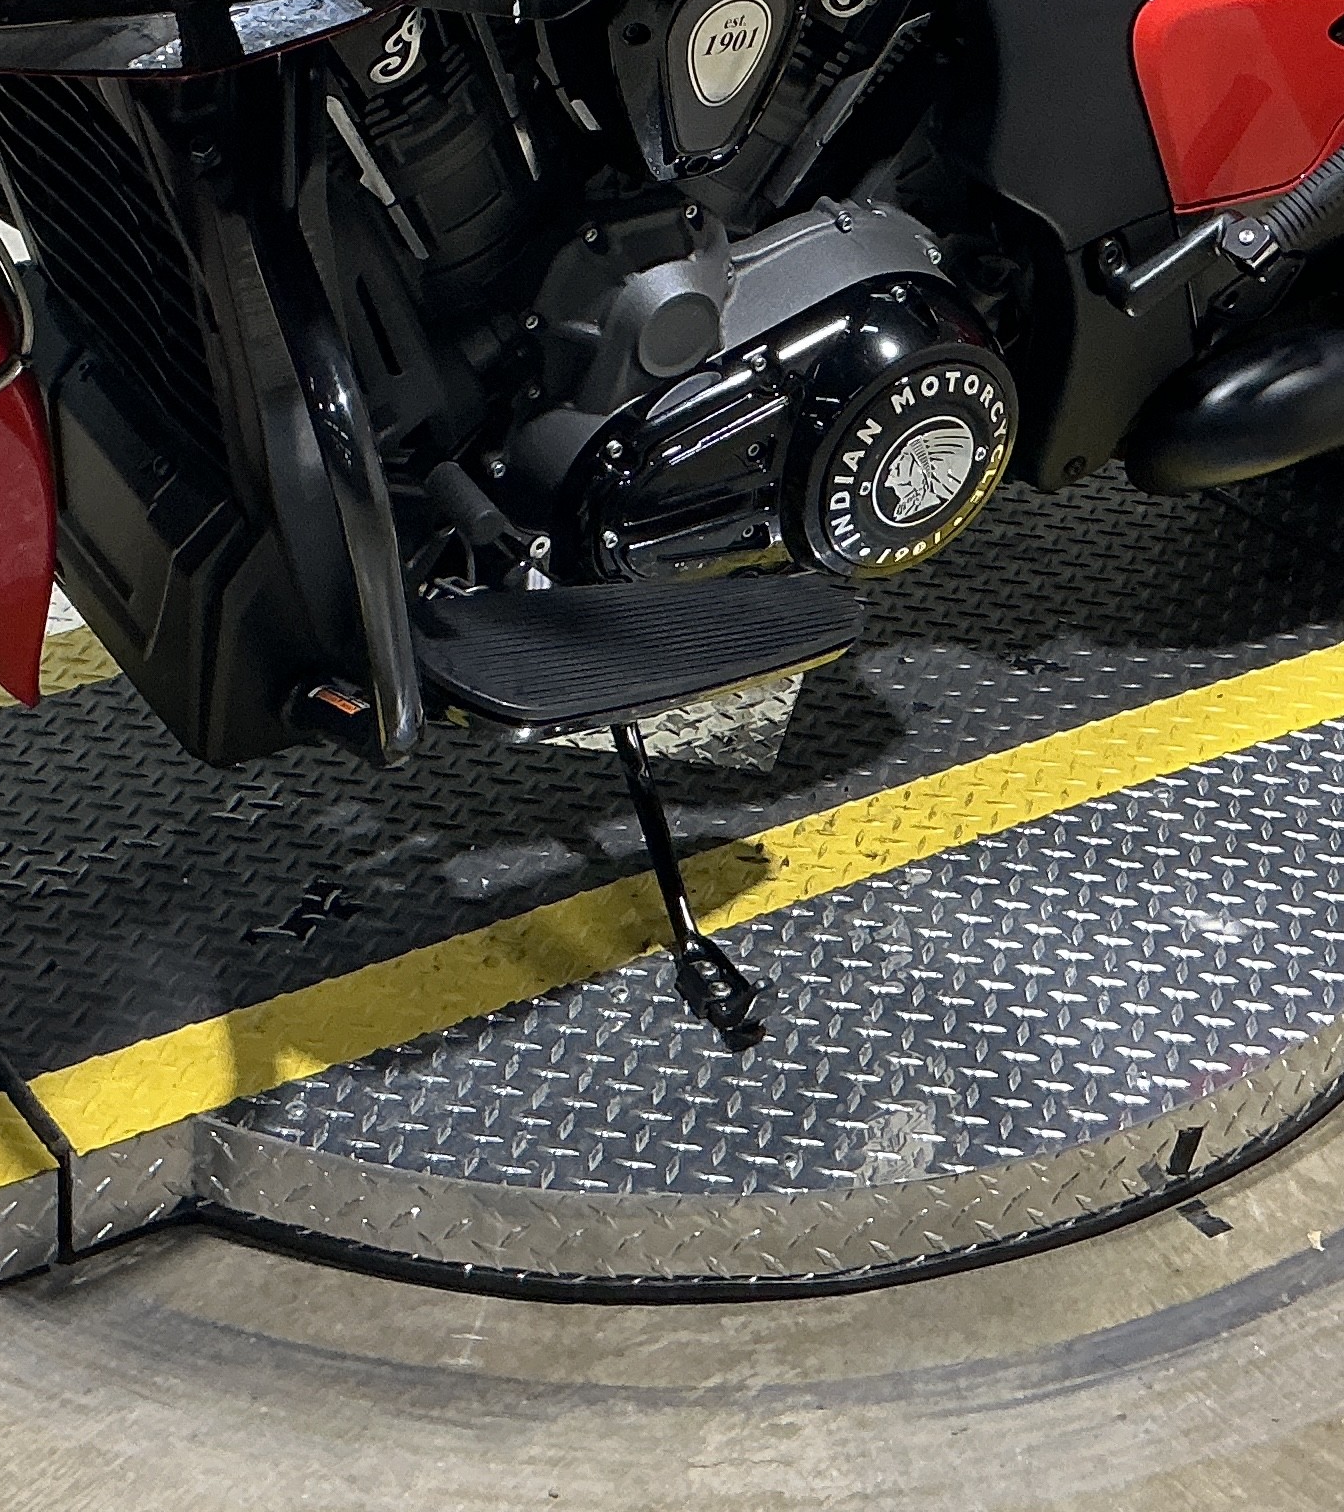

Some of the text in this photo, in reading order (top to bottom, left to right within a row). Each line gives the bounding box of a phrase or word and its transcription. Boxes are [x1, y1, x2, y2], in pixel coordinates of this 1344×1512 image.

[701, 26, 759, 56] 1901
[829, 370, 1008, 549] INDIAN MOTORCYCLE
